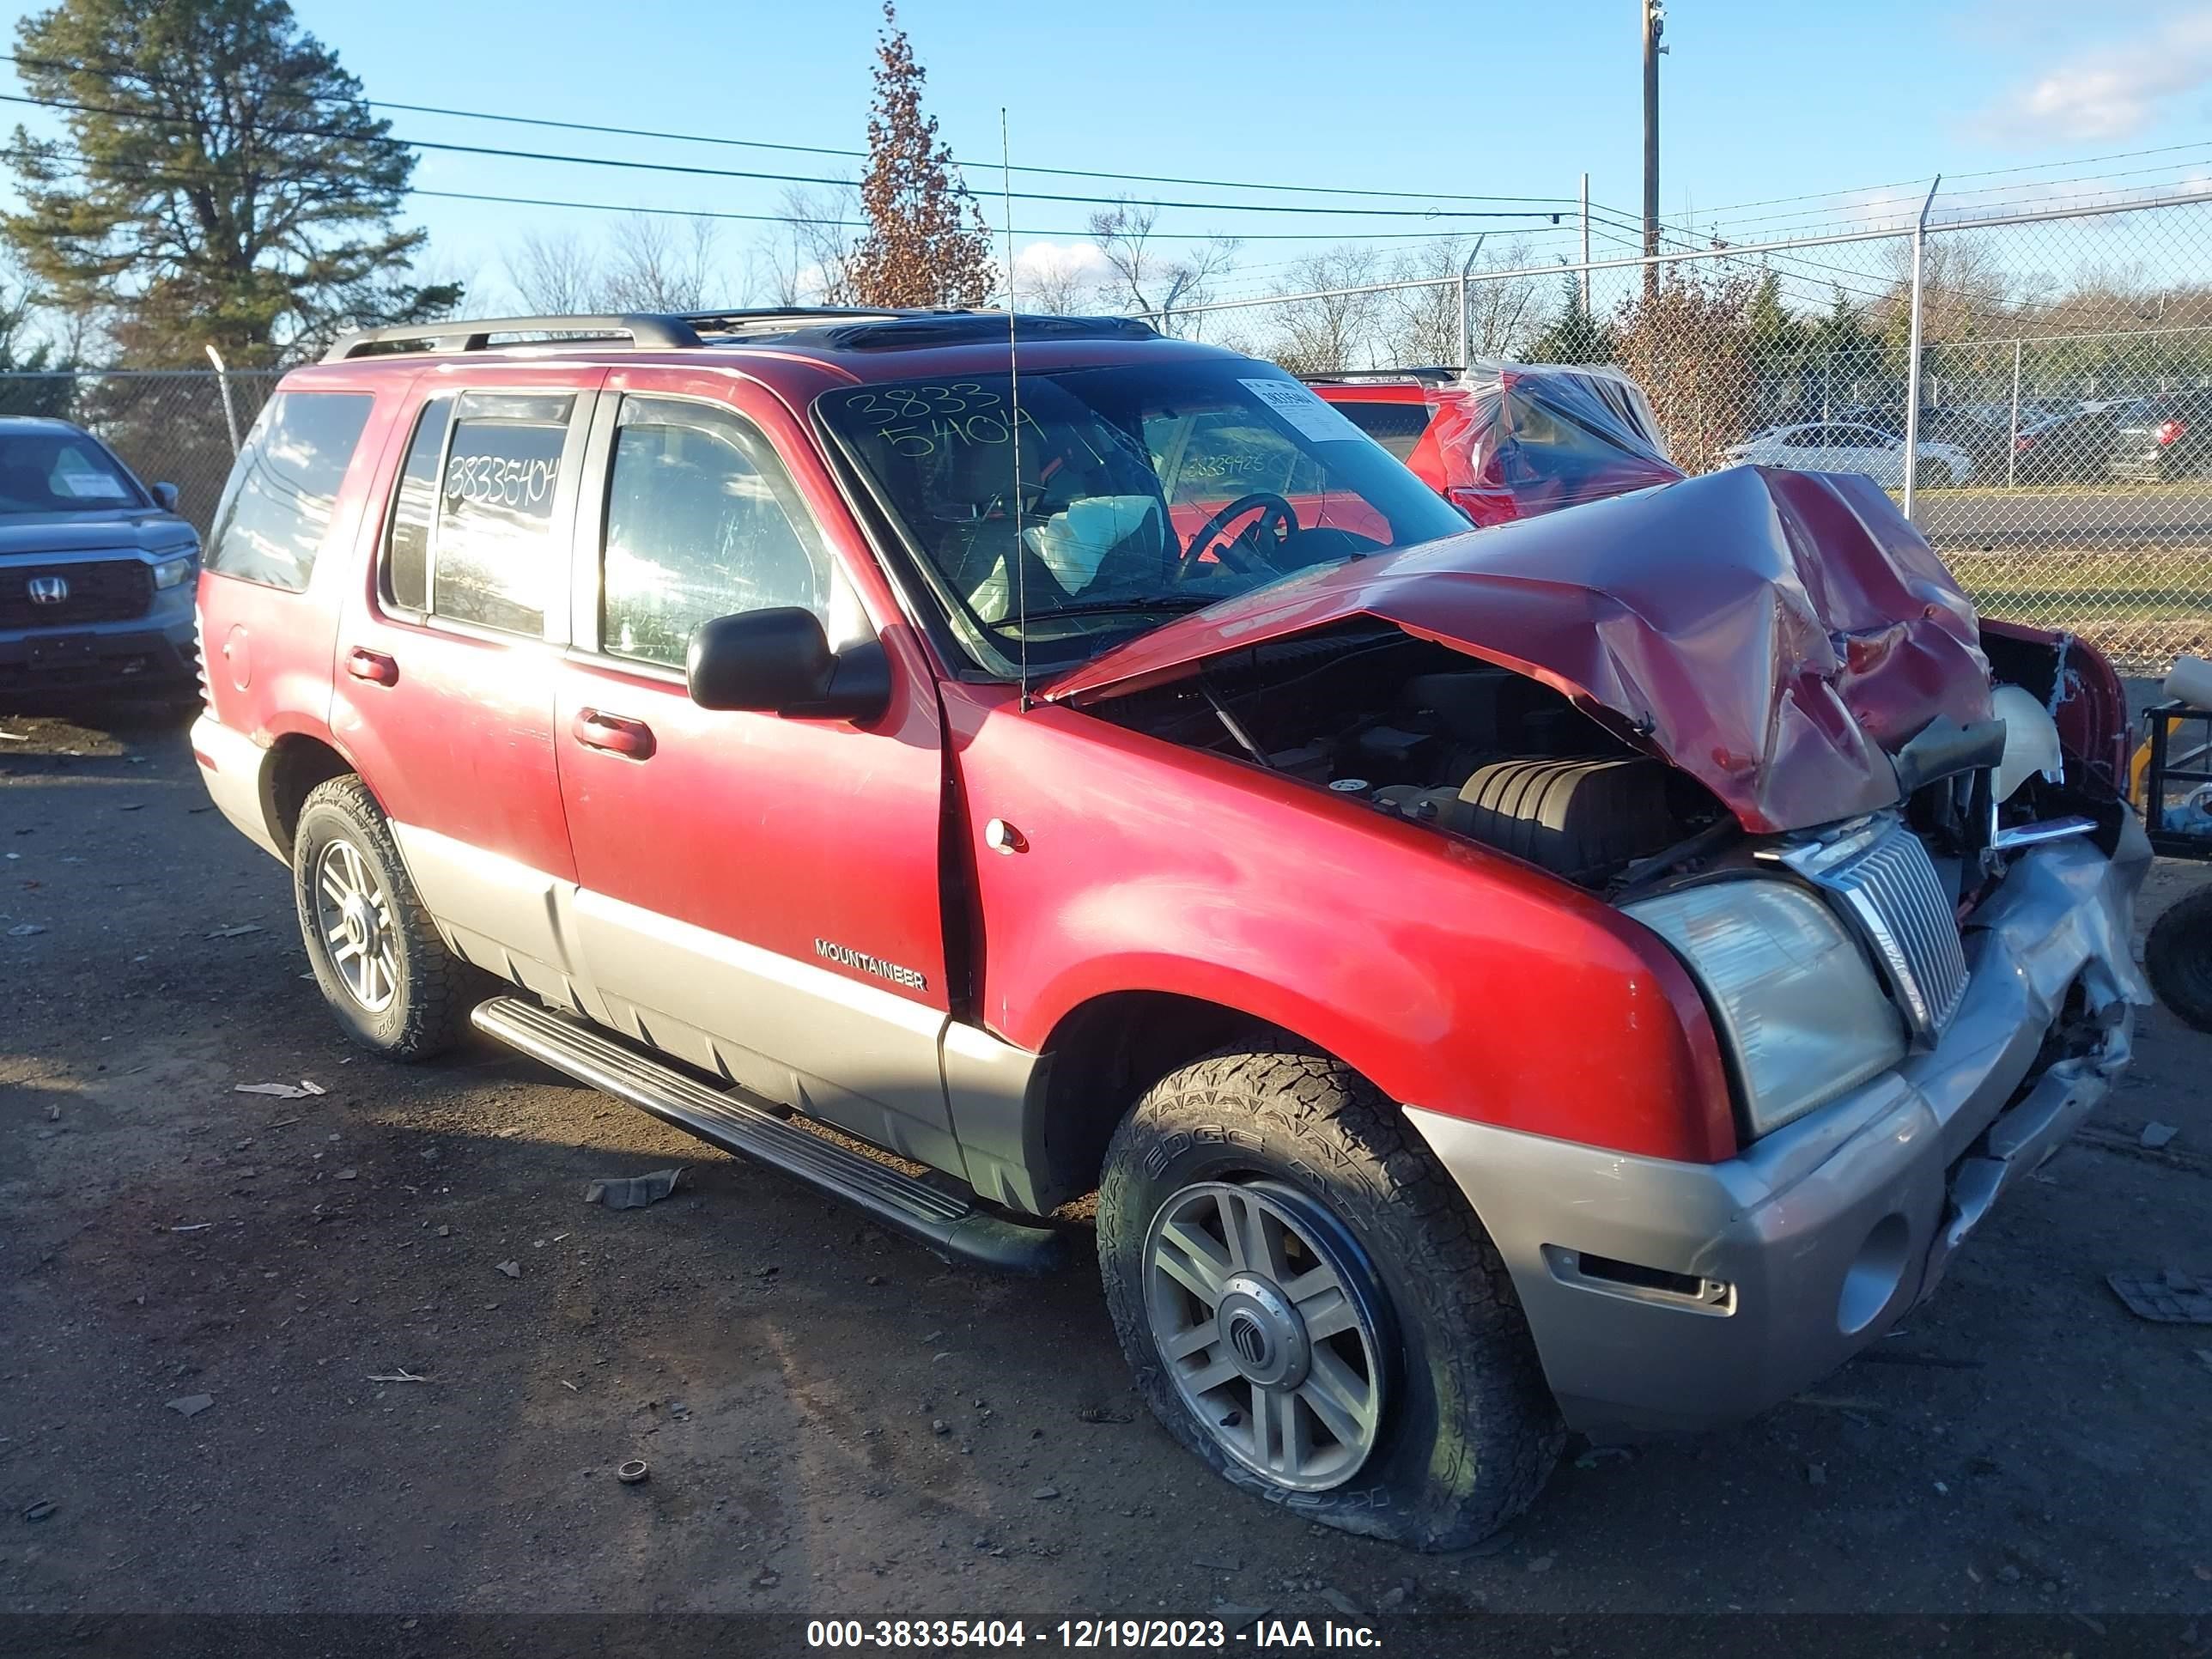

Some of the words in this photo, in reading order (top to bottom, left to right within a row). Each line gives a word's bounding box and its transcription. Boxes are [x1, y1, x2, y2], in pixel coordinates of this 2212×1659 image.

[845, 384, 1001, 425] 3833
[876, 408, 1048, 457] 5404
[447, 455, 561, 507] 38335404
[814, 937, 929, 993] MOUNTAINEER
[1143, 1124, 1266, 1181] EDGE
